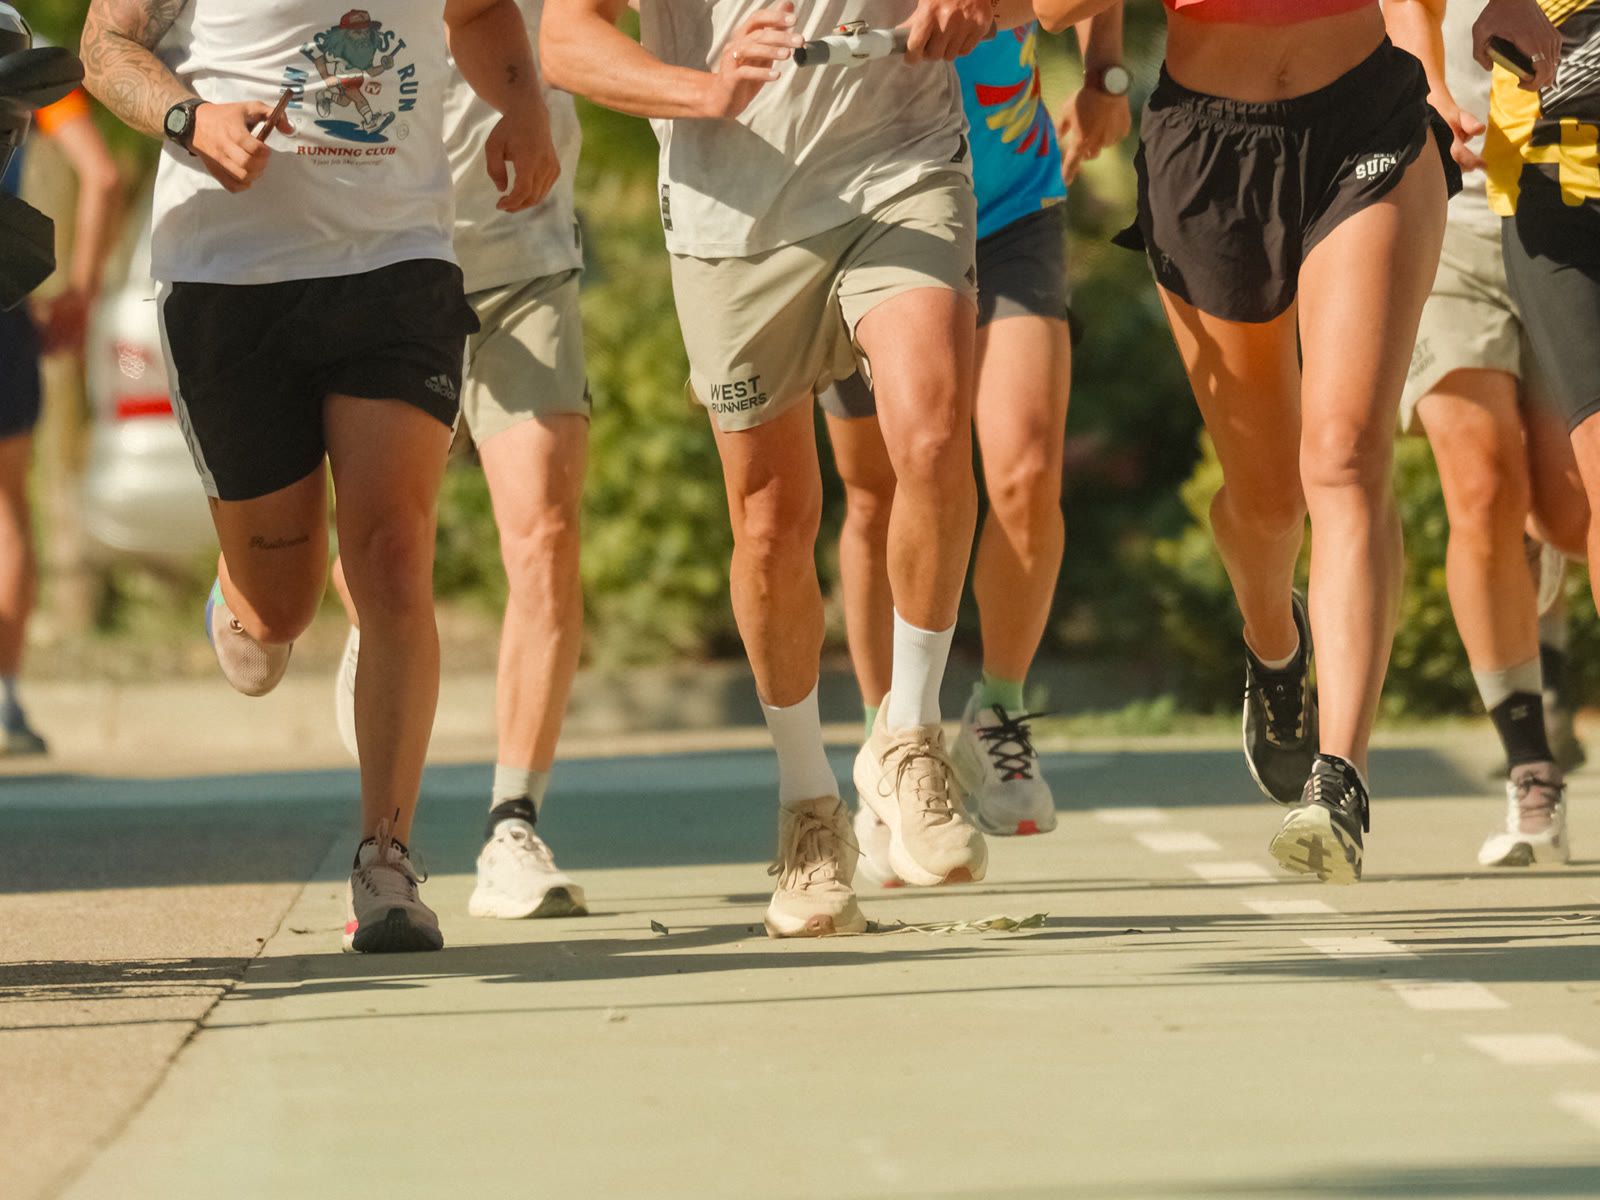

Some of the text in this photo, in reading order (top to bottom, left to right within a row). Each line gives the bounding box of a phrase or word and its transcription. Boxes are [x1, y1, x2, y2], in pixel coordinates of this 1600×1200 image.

[397, 63, 418, 111] RUN
[296, 145, 396, 157] RUNNING CLUB
[424, 379, 456, 400] adidas
[710, 375, 761, 400] WEST
[711, 393, 767, 413] RUNNERS
